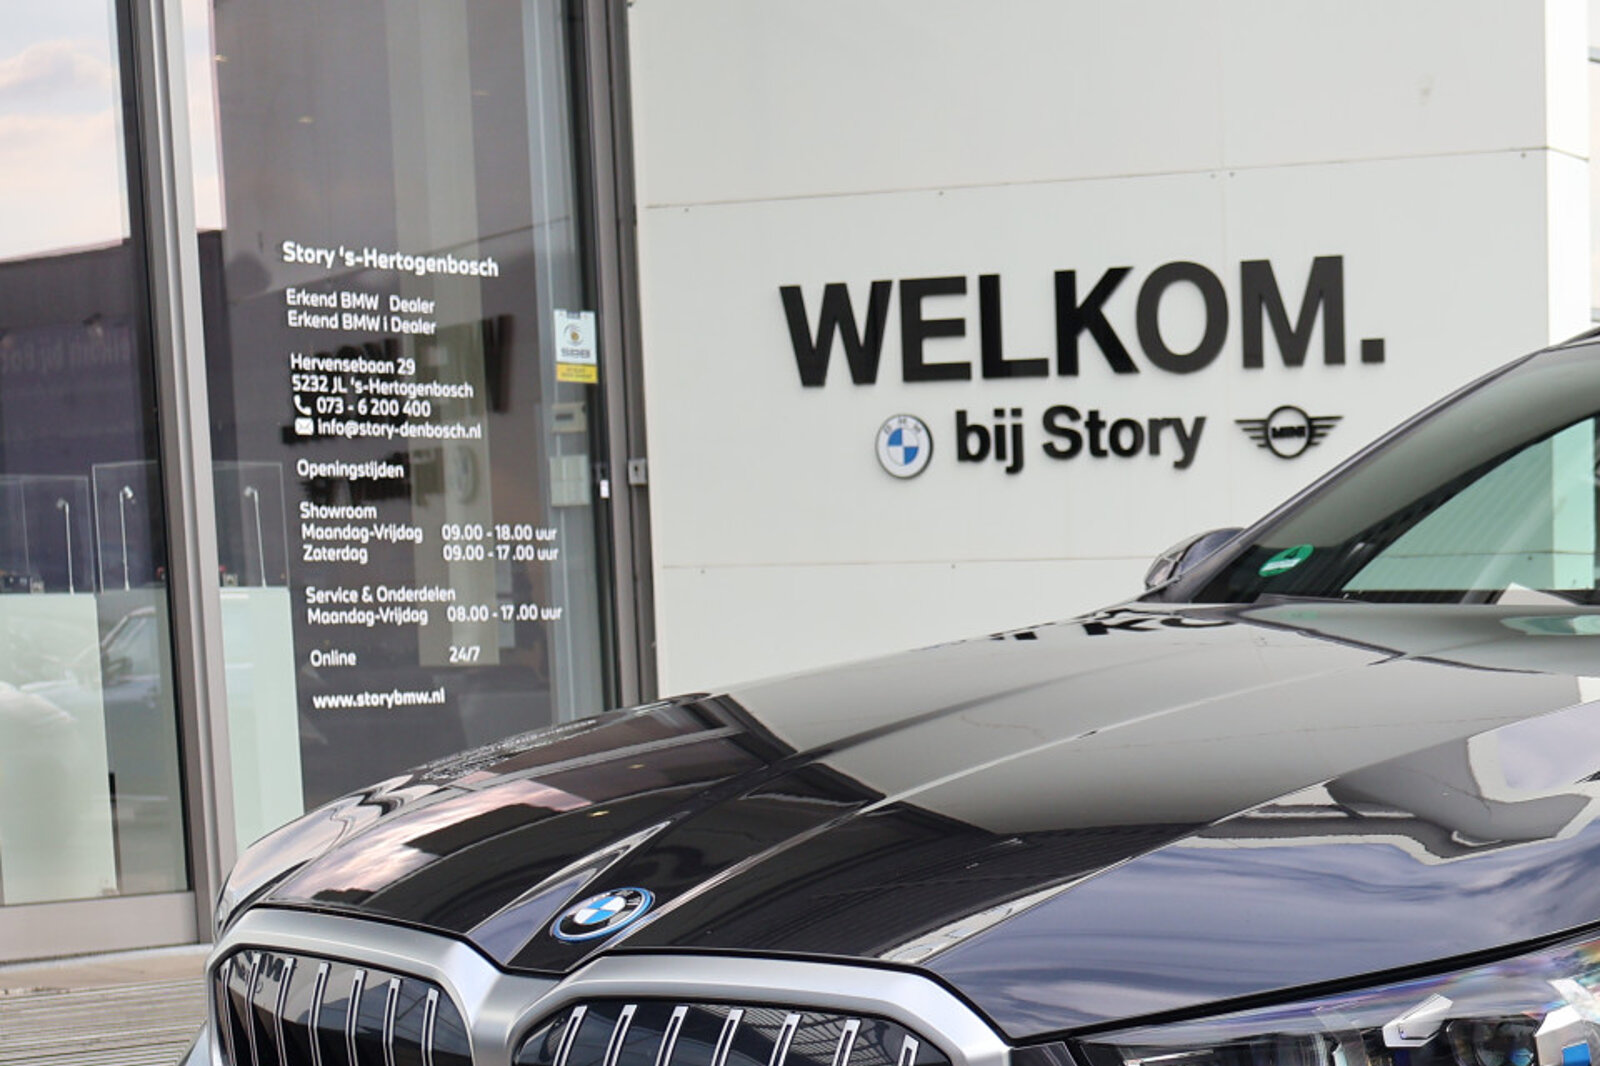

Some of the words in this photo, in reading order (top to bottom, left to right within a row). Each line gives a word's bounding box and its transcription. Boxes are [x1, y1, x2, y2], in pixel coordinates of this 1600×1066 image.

[282, 241, 335, 269] Story
[339, 245, 499, 277] 's-Hertogenbosch
[285, 288, 337, 308] Erkend
[341, 291, 379, 311] BMW
[389, 295, 435, 314] Dealer
[287, 310, 339, 330] Erkend
[342, 313, 381, 332] BMW
[391, 317, 437, 335] Dealer
[780, 254, 1386, 387] WELKOM.
[290, 353, 394, 375] Hervensebaan
[397, 358, 416, 376] 29
[291, 375, 329, 393] 5232
[331, 376, 347, 394] JL
[316, 397, 344, 414] 073
[357, 399, 368, 416] 6
[370, 399, 399, 416] 200
[402, 400, 431, 417] 400
[317, 418, 482, 440] info@story-denbosch.nl
[955, 408, 1024, 475] bij
[1041, 405, 1207, 470] Story
[297, 459, 405, 480] Openingstijden
[299, 502, 377, 519] Showroom
[301, 523, 423, 544] Maandag-Vrijdag
[441, 524, 483, 541] 09.00
[495, 524, 533, 541] 18.00
[535, 526, 557, 541] uur
[303, 544, 368, 565] Zaterdag
[442, 545, 485, 561] 09.00
[537, 547, 559, 561] uur
[305, 586, 358, 604] Service
[362, 586, 373, 602] &
[376, 585, 456, 602] Onderdelen
[307, 606, 429, 626] Maandag-Vrijdag
[447, 605, 489, 622] 08.00
[541, 607, 563, 620] uur
[310, 649, 356, 667] Online
[449, 645, 481, 662] 24/7
[313, 687, 445, 709] www.storybmw.nl
